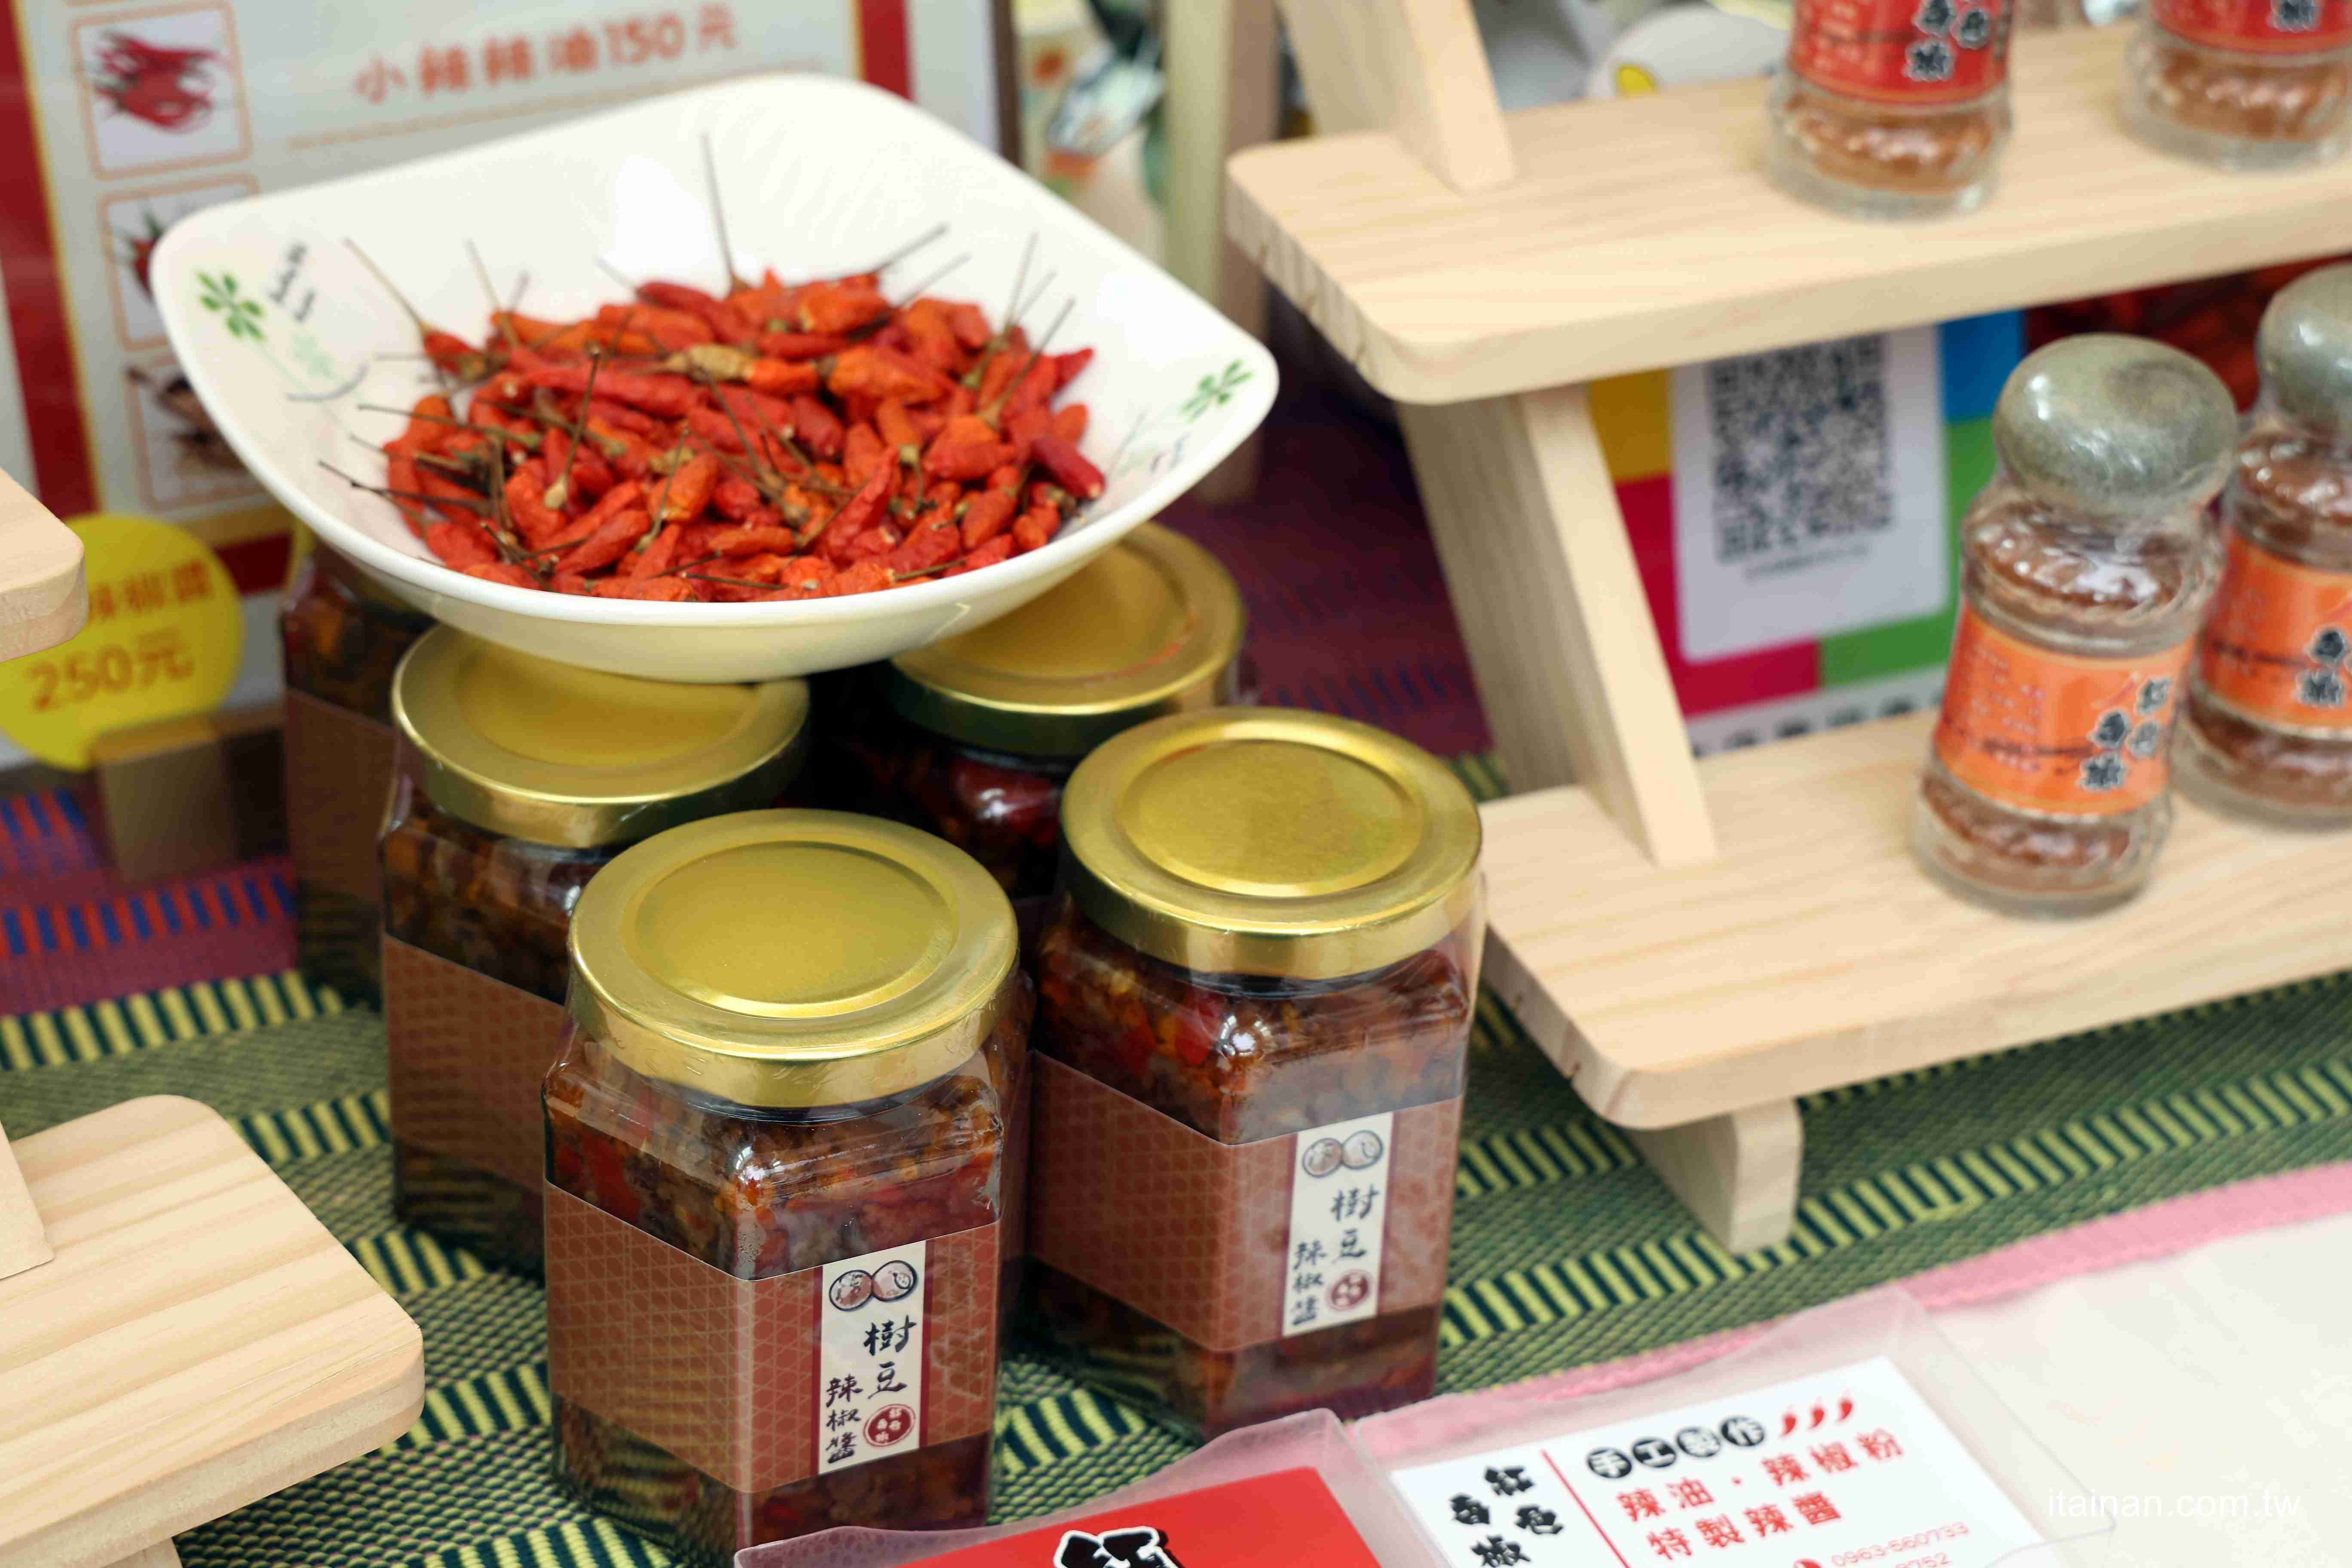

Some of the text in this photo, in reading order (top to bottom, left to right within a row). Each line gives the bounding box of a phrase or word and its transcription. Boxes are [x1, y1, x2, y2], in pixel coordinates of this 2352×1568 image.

[1330, 1183, 1380, 1265] 樹豆
[863, 1314, 917, 1400] 樹豆
[825, 1373, 864, 1463] 辣椒醬
[1587, 1415, 1765, 1479] 手工製作
[1647, 1491, 1842, 1561] 特製辣醬
